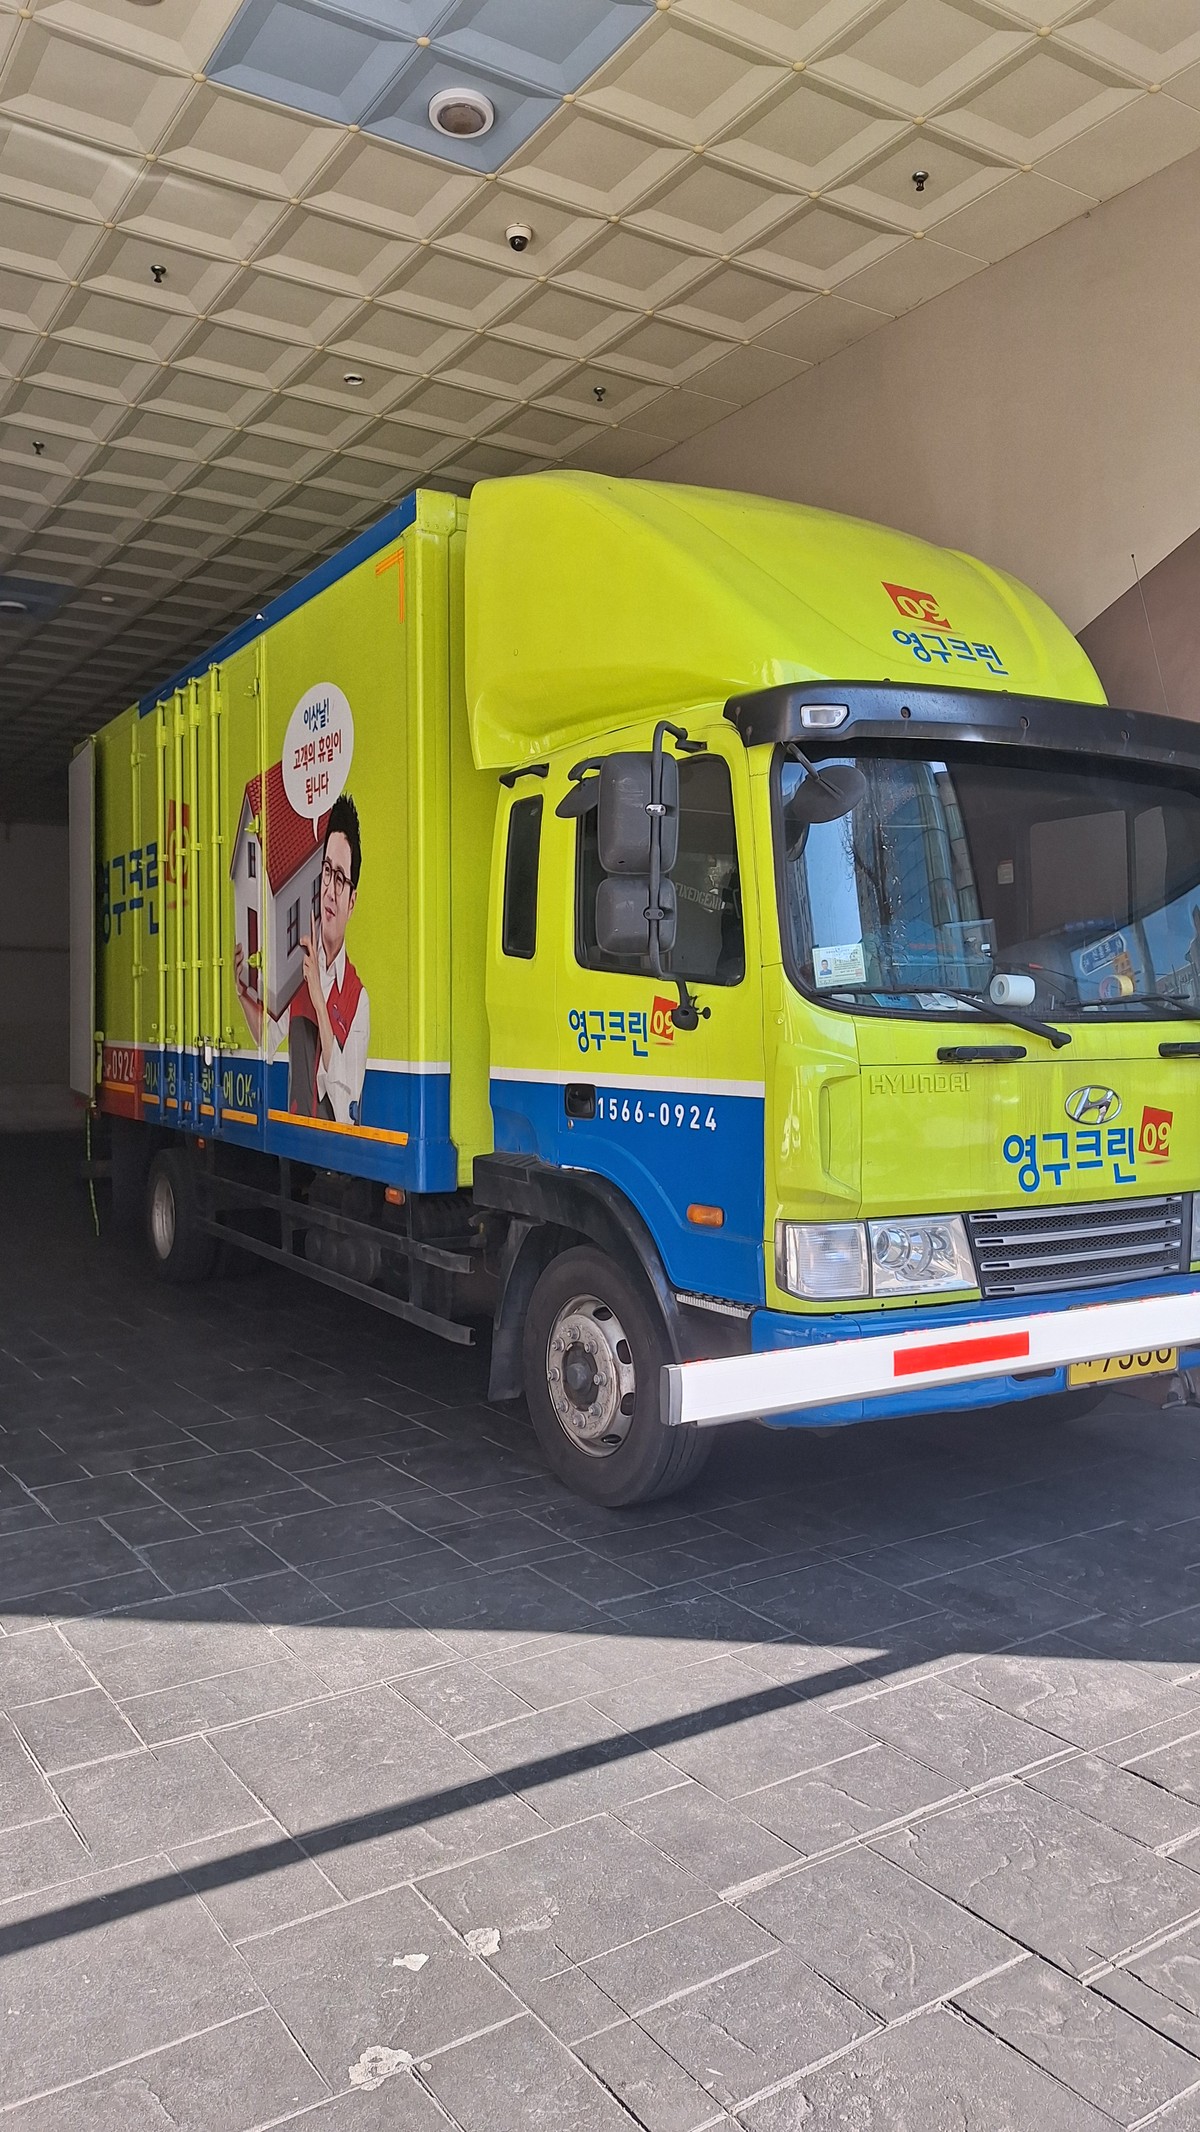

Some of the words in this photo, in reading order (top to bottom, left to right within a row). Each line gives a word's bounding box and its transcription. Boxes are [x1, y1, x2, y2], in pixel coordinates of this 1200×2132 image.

[896, 595, 946, 622] 09
[892, 629, 1009, 675] 영구크린
[303, 697, 330, 732] 이삿날!
[293, 740, 316, 771] 고객의
[317, 728, 342, 763] 휴일이
[305, 770, 330, 805] 됩니다
[568, 1009, 649, 1057] 영구크린
[869, 1072, 971, 1095] HYUNDAI
[597, 1097, 717, 1131] 1566-0924
[1002, 1127, 1137, 1193] 영구크린
[1142, 1122, 1173, 1151] 09
